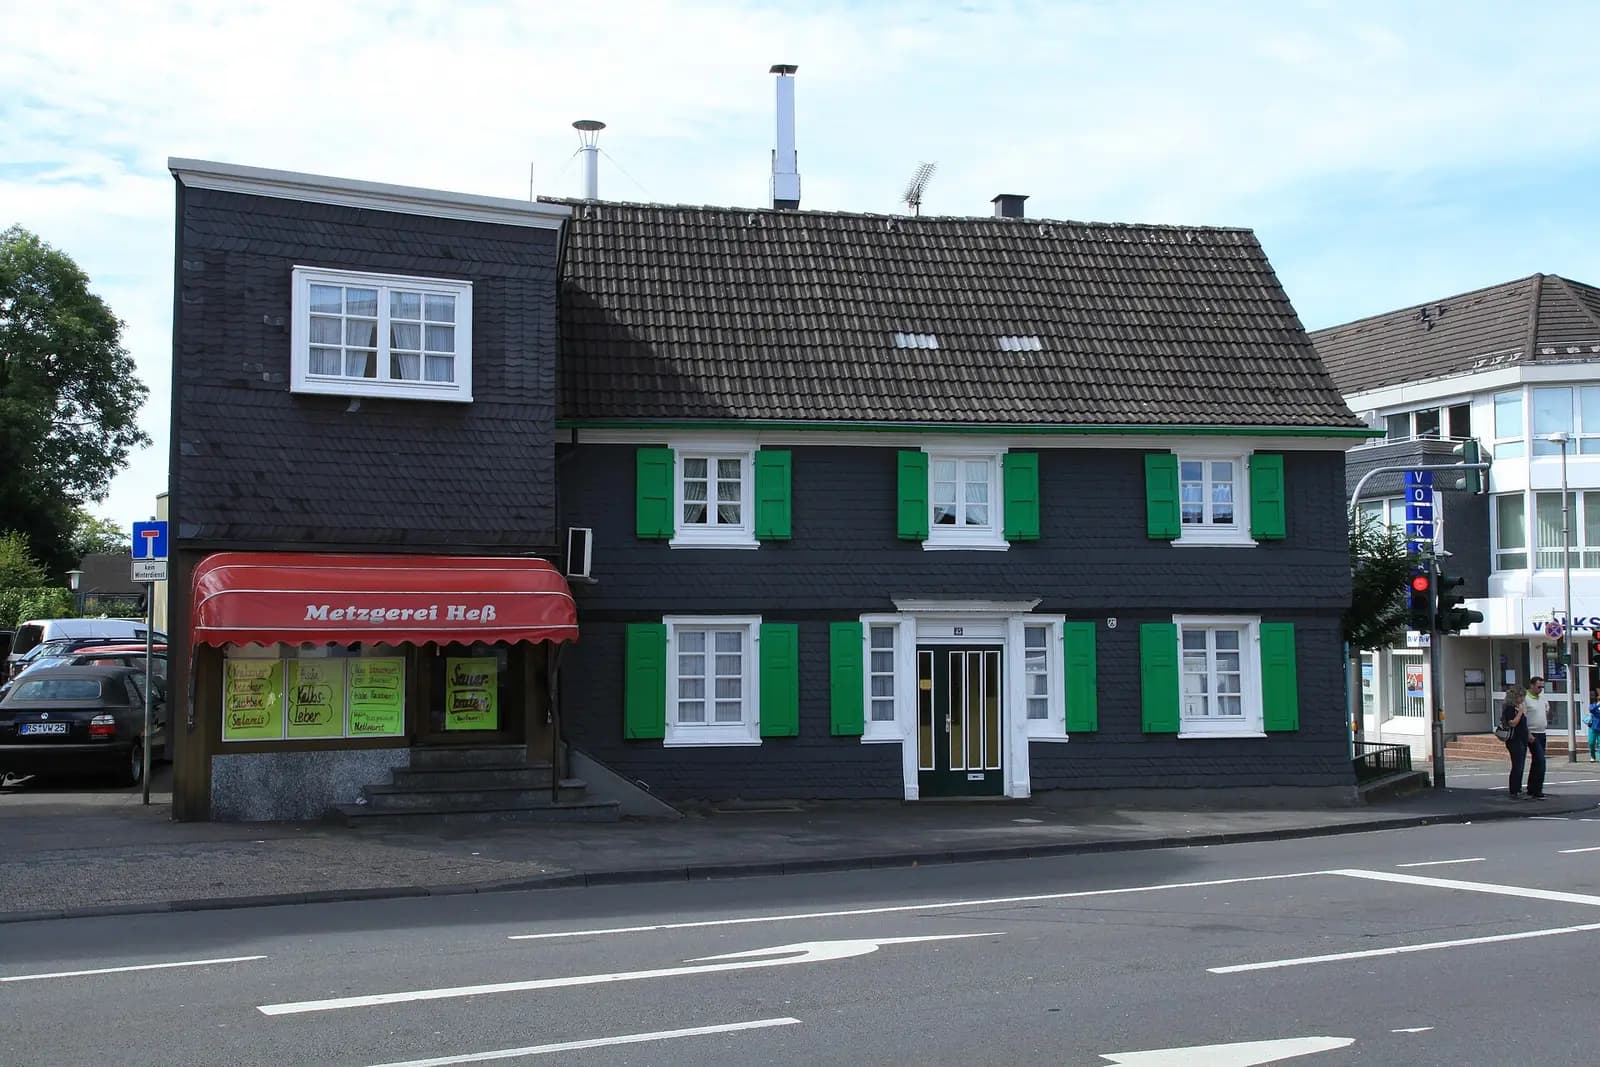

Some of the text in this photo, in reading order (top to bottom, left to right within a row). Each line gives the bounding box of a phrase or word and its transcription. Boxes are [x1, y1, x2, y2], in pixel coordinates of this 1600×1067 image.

[1414, 471, 1424, 570] VOLKS
[135, 571, 165, 579] Winterdienst
[303, 604, 497, 624] Metzgerei Heß
[294, 705, 321, 723] Leber
[54, 723, 65, 732] 25
